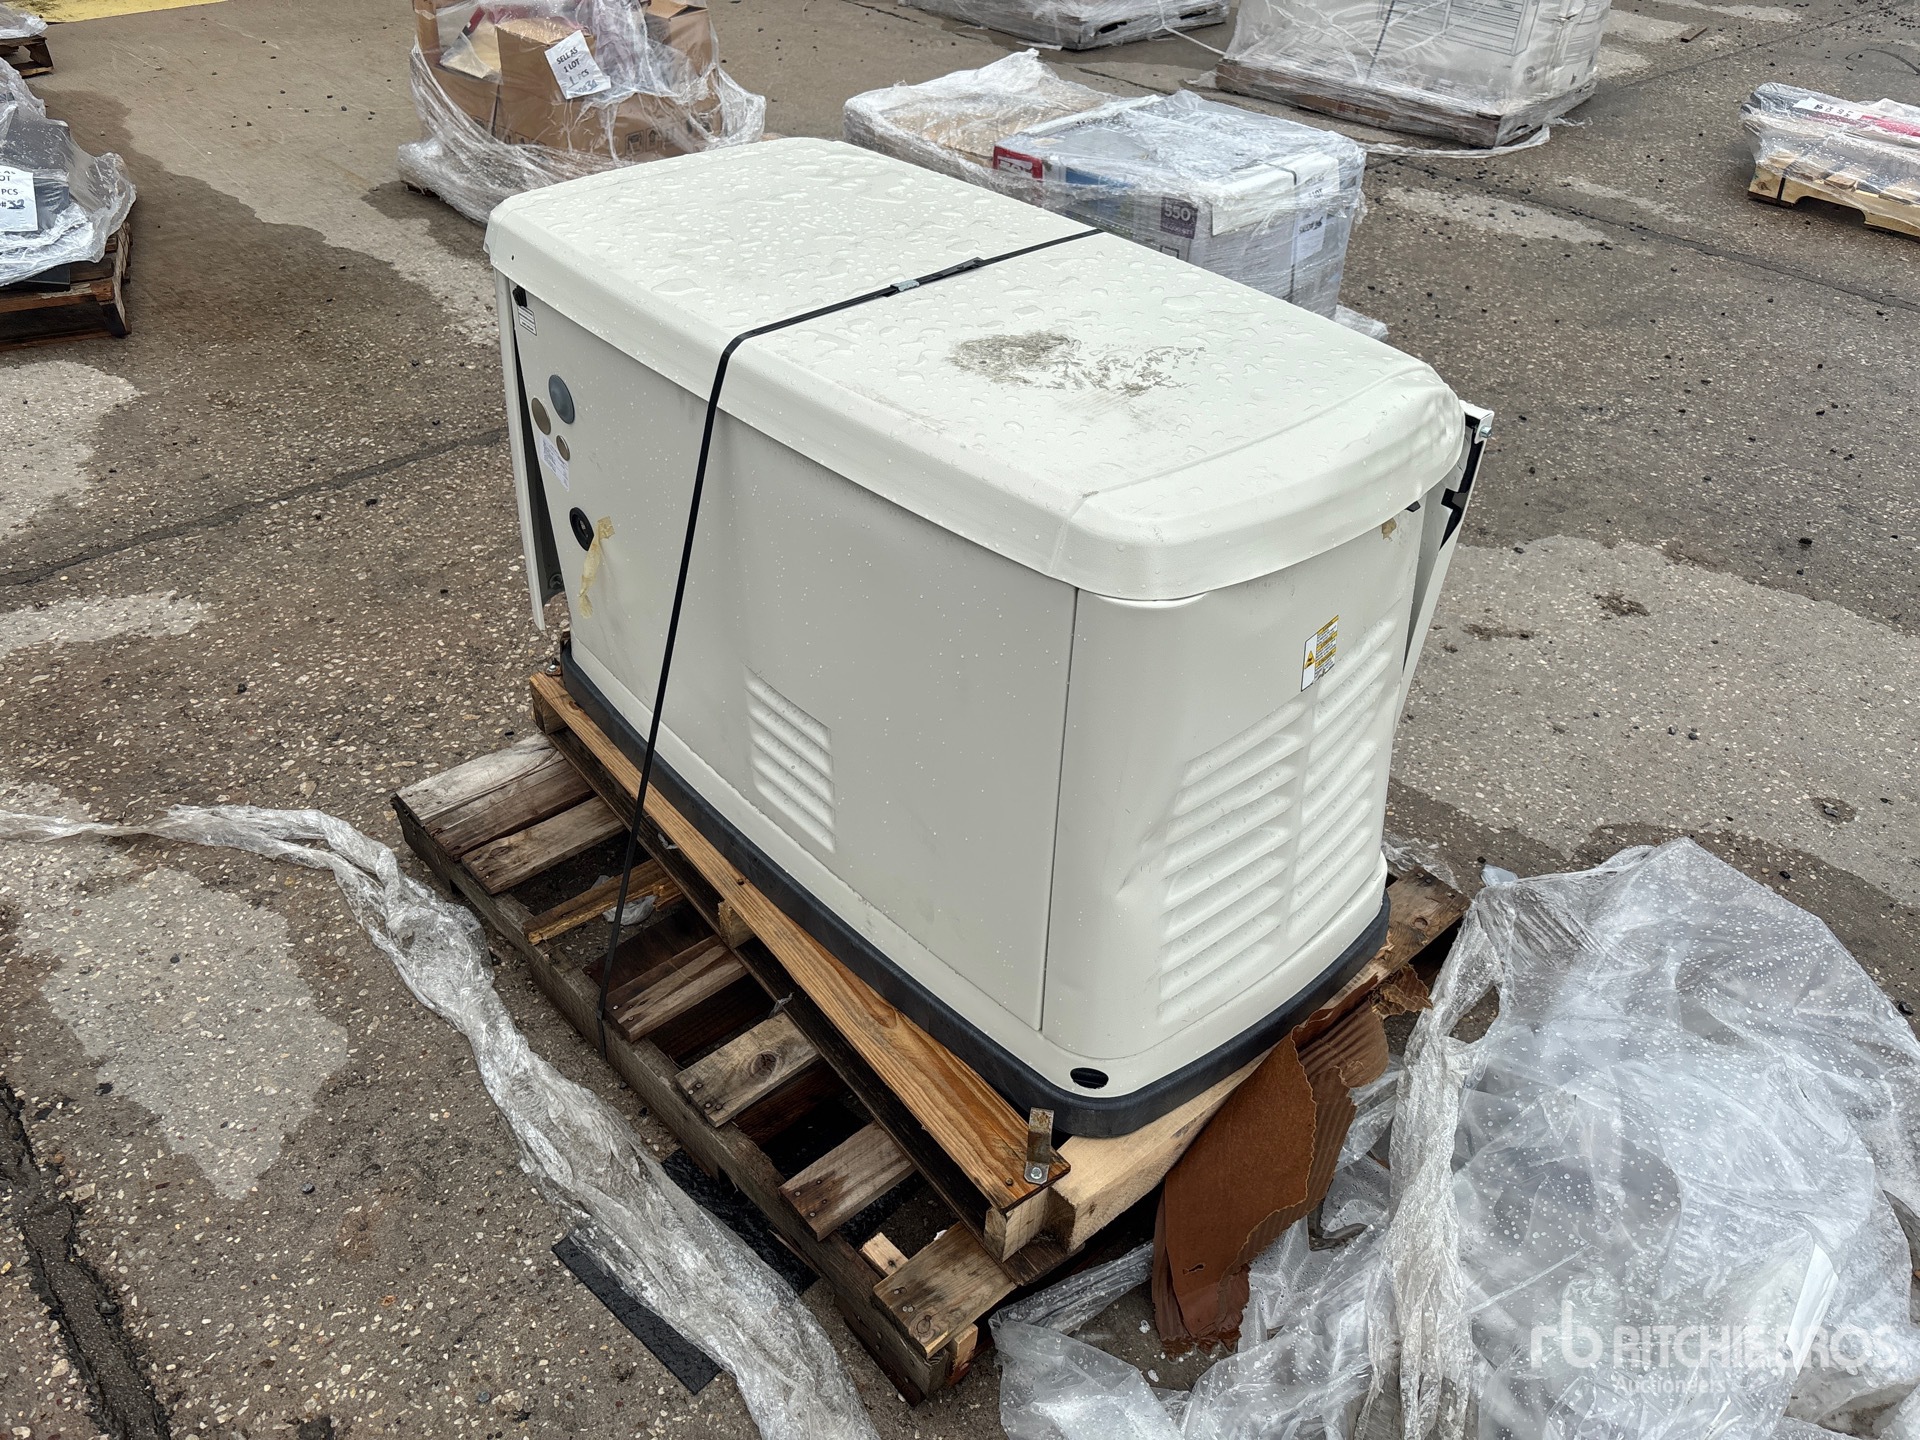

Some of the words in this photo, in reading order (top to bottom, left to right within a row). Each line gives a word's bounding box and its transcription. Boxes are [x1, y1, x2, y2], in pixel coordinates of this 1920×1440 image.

[557, 53, 570, 64] SELL
[568, 58, 580, 70] LOT
[1, 188, 19, 196] PCS
[1164, 203, 1191, 221] 550
